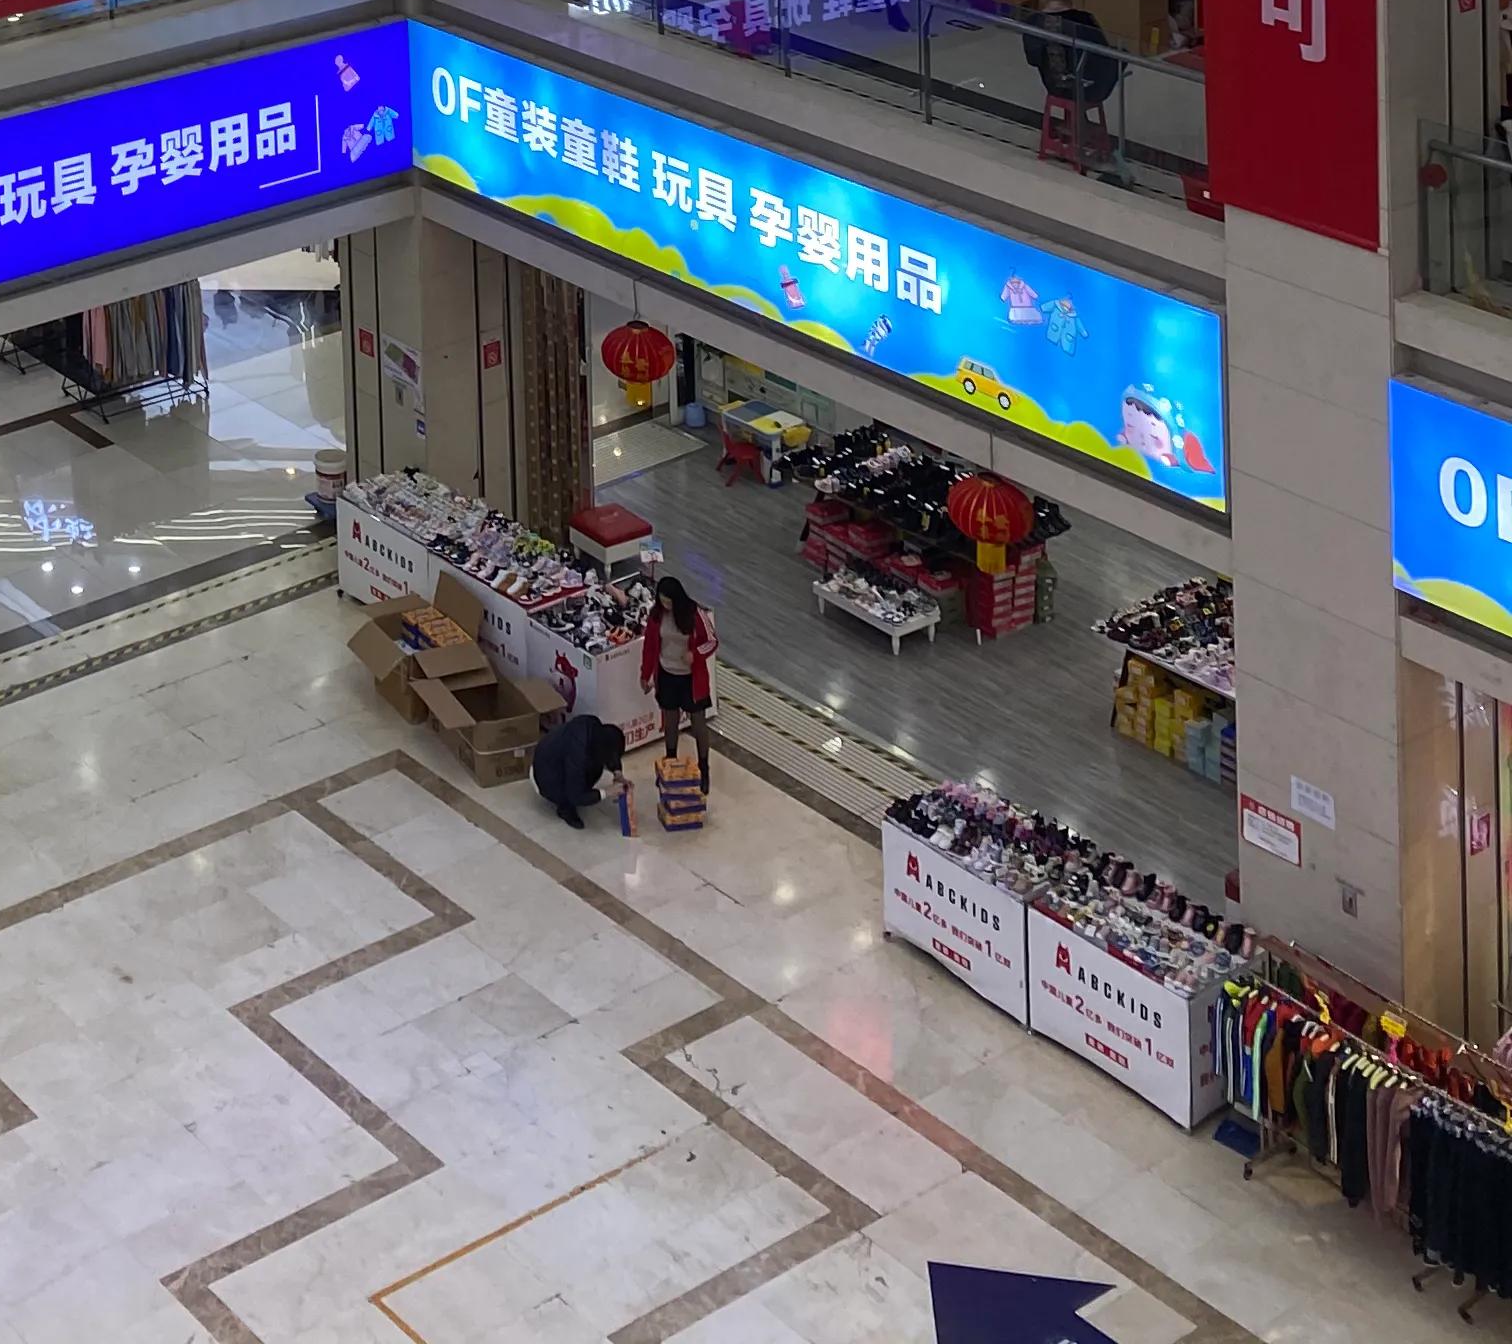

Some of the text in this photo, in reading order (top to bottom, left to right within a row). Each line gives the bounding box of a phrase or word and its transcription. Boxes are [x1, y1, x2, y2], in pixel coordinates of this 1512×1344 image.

[0, 154, 98, 227] 玩具
[110, 101, 298, 198] 孕婴用品
[651, 149, 738, 233] 玩具
[748, 184, 945, 317] 孕婴用品
[364, 533, 414, 575] ABCKIDS
[925, 874, 1000, 931] ABCKIDS
[1077, 966, 1162, 1030] ABCKIDS
